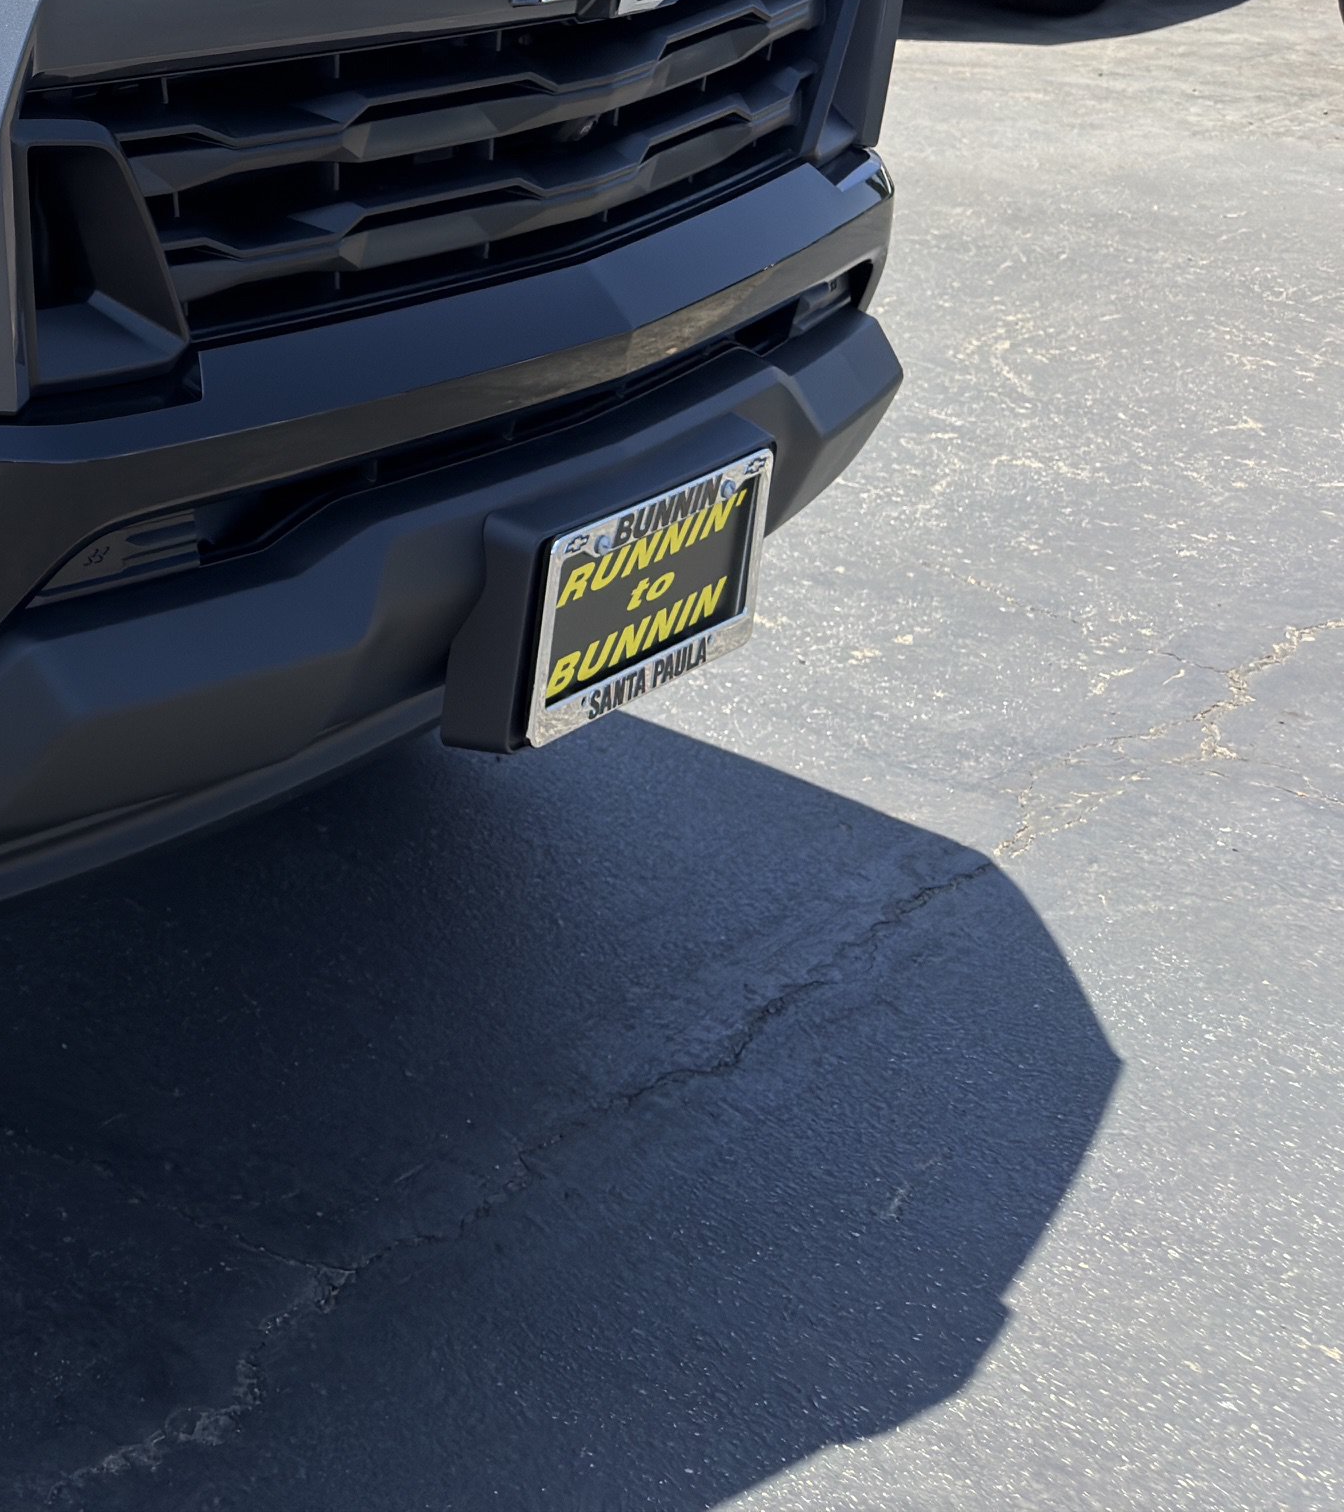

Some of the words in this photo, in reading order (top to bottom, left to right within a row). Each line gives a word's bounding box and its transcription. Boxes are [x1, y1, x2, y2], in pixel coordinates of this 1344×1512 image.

[615, 474, 723, 541] BUNNIN
[626, 571, 675, 611] to
[545, 576, 728, 699] BUNNIN
[588, 670, 647, 720] SANTA
[652, 641, 707, 688] PAULA
